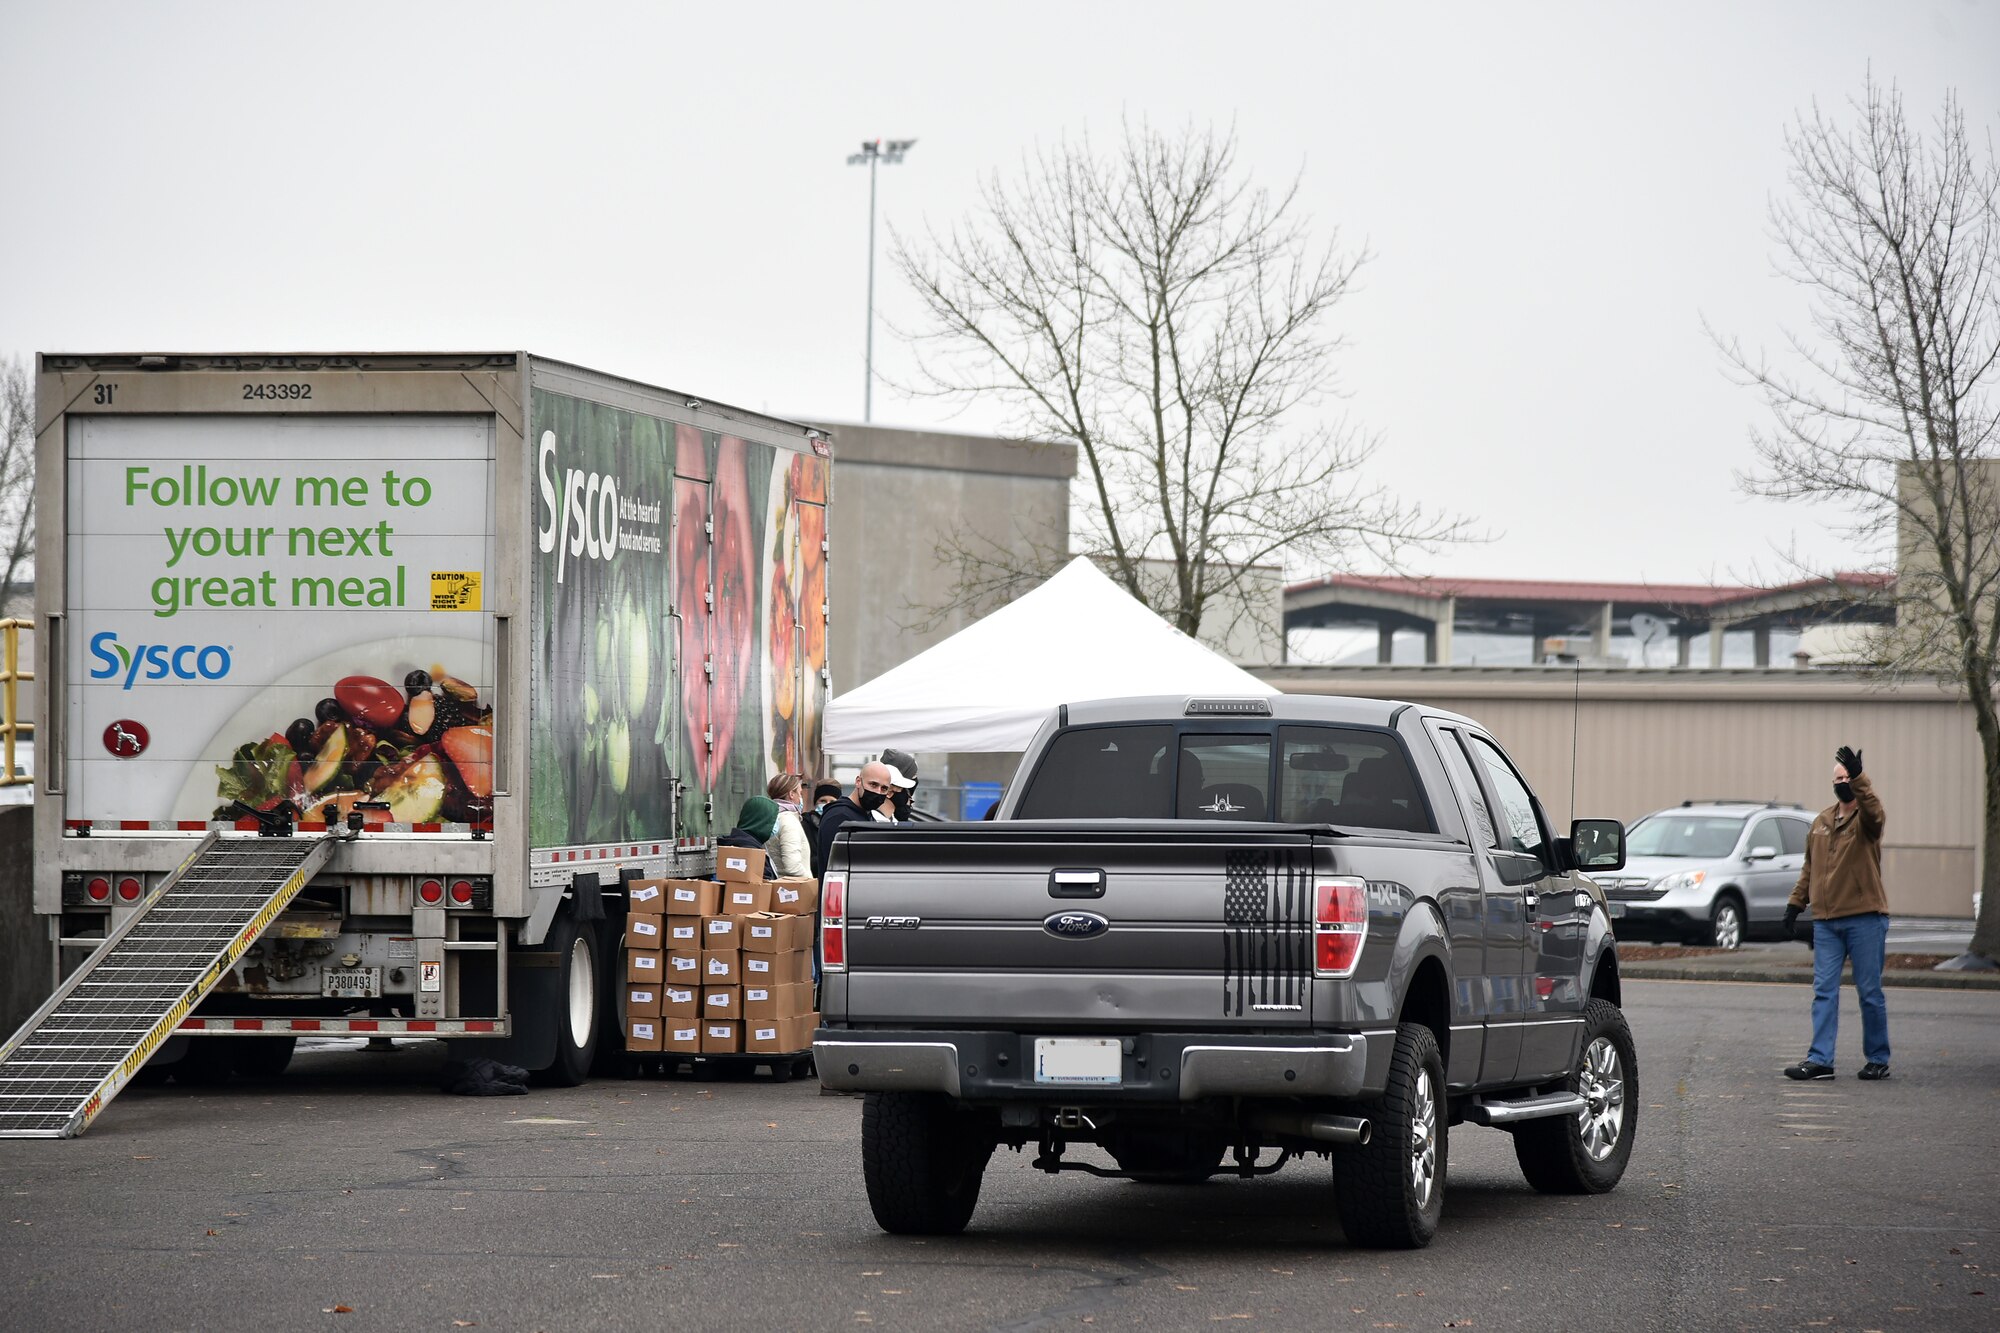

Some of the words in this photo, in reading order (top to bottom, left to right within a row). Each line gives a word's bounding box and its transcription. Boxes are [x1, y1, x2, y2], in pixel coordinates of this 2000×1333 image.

[94, 384, 118, 404] 31'
[243, 384, 312, 400] 243392
[126, 465, 281, 506] Follow
[295, 477, 369, 506] me
[382, 470, 432, 507] to
[619, 495, 627, 520] At
[627, 496, 637, 521] the
[637, 497, 654, 524] heart
[653, 500, 661, 525] of
[164, 521, 274, 568] your
[288, 520, 394, 557] next
[619, 526, 633, 550] food
[632, 529, 643, 552] and
[642, 531, 661, 554] service
[431, 573, 465, 581] CAUTION
[151, 571, 277, 618] great
[291, 565, 406, 607] meal
[1057, 915, 1092, 932] Ford
[328, 975, 371, 990] P380493
